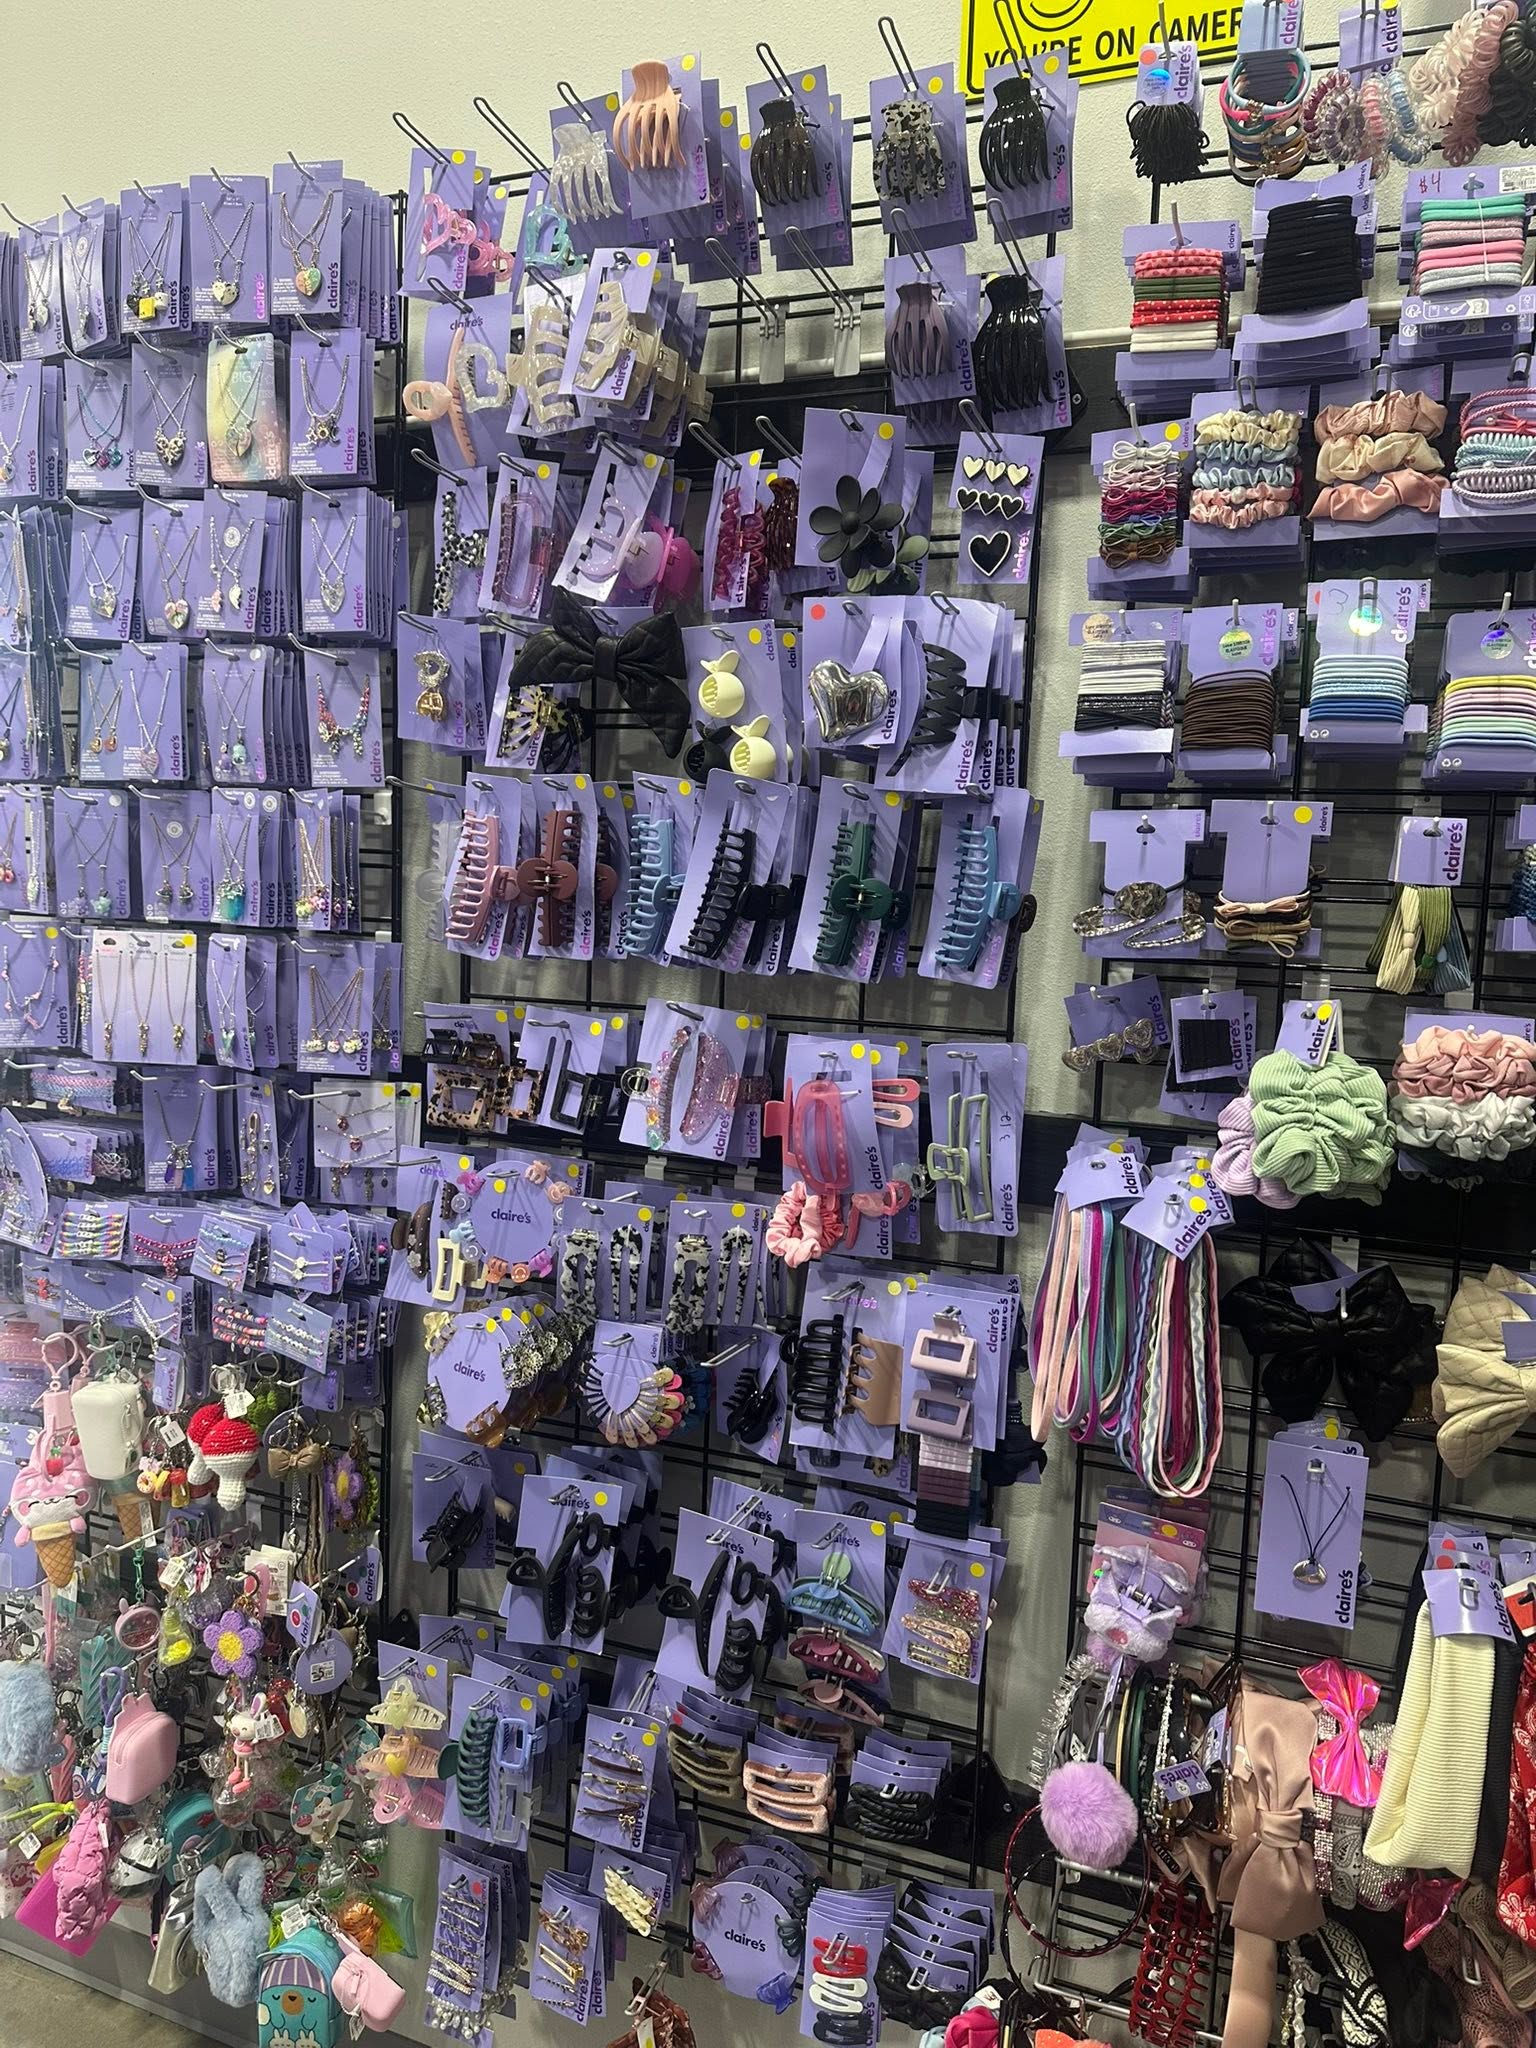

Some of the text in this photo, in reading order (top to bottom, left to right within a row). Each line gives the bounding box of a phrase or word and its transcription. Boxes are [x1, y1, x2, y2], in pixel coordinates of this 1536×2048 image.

[1095, 26, 1135, 60] ON
[1149, 11, 1243, 44] CAMER
[1381, 9, 1398, 54] claire
[1174, 45, 1193, 99] claire's
[1357, 162, 1369, 190] claire's
[1418, 170, 1442, 194] $4
[169, 280, 178, 325] claire's
[181, 285, 190, 329] claire's
[329, 262, 339, 308] claire's
[611, 354, 632, 396] claire's
[963, 339, 973, 391] claire's
[1055, 370, 1068, 426] claire's
[344, 426, 355, 471] claire's
[1182, 421, 1190, 447] claire's
[45, 455, 55, 496] claire's
[1013, 528, 1031, 579] claire's
[736, 557, 747, 604] claire's
[119, 598, 131, 639] claire's
[245, 586, 256, 630] claire's
[262, 589, 272, 633] claire's
[1287, 611, 1295, 637] claire's
[1391, 586, 1411, 643] claire's
[766, 621, 775, 662] claire's
[1260, 608, 1277, 666] claire's
[454, 700, 463, 745] claire's
[882, 689, 898, 739] claire's
[170, 735, 180, 777] claire's
[370, 740, 382, 783] claire's
[957, 740, 973, 790] claire's
[982, 739, 993, 790] claire's
[1320, 806, 1329, 832] claire's
[1442, 822, 1463, 881] claire's
[118, 878, 127, 915] claire's
[200, 876, 209, 917] claire's
[266, 882, 275, 925] claire's
[489, 910, 504, 957] claire's
[581, 910, 592, 956] claire's
[767, 924, 781, 972] claire's
[859, 929, 875, 978] claire's
[894, 928, 906, 973] claire's
[57, 1006, 68, 1045] claire's
[1150, 994, 1169, 1043] claire's
[1307, 1018, 1328, 1060] claire
[356, 1030, 370, 1072] claire's
[1232, 1017, 1242, 1072] claire's
[714, 1113, 730, 1158] claire's
[748, 1110, 757, 1156] claire's
[205, 1148, 216, 1187] claire's
[296, 1158, 305, 1196] claire's
[871, 1145, 885, 1190] claire's
[1122, 1155, 1140, 1195] claire's
[491, 1208, 532, 1224] claire's
[1001, 1184, 1017, 1232] claire's
[1175, 1209, 1212, 1255] claire's
[987, 1308, 1000, 1354] claire's
[167, 1367, 175, 1406] claire's
[453, 1361, 486, 1382] claire's
[364, 1561, 375, 1603] claire's
[1335, 1569, 1353, 1625] claire's
[1490, 1581, 1511, 1637] claire's
[1160, 1765, 1201, 1789] claire's
[631, 1803, 645, 1848] claire's
[725, 1930, 766, 1953] claire's
[575, 1978, 589, 2022] claire's
[592, 1970, 602, 2015] claire's
